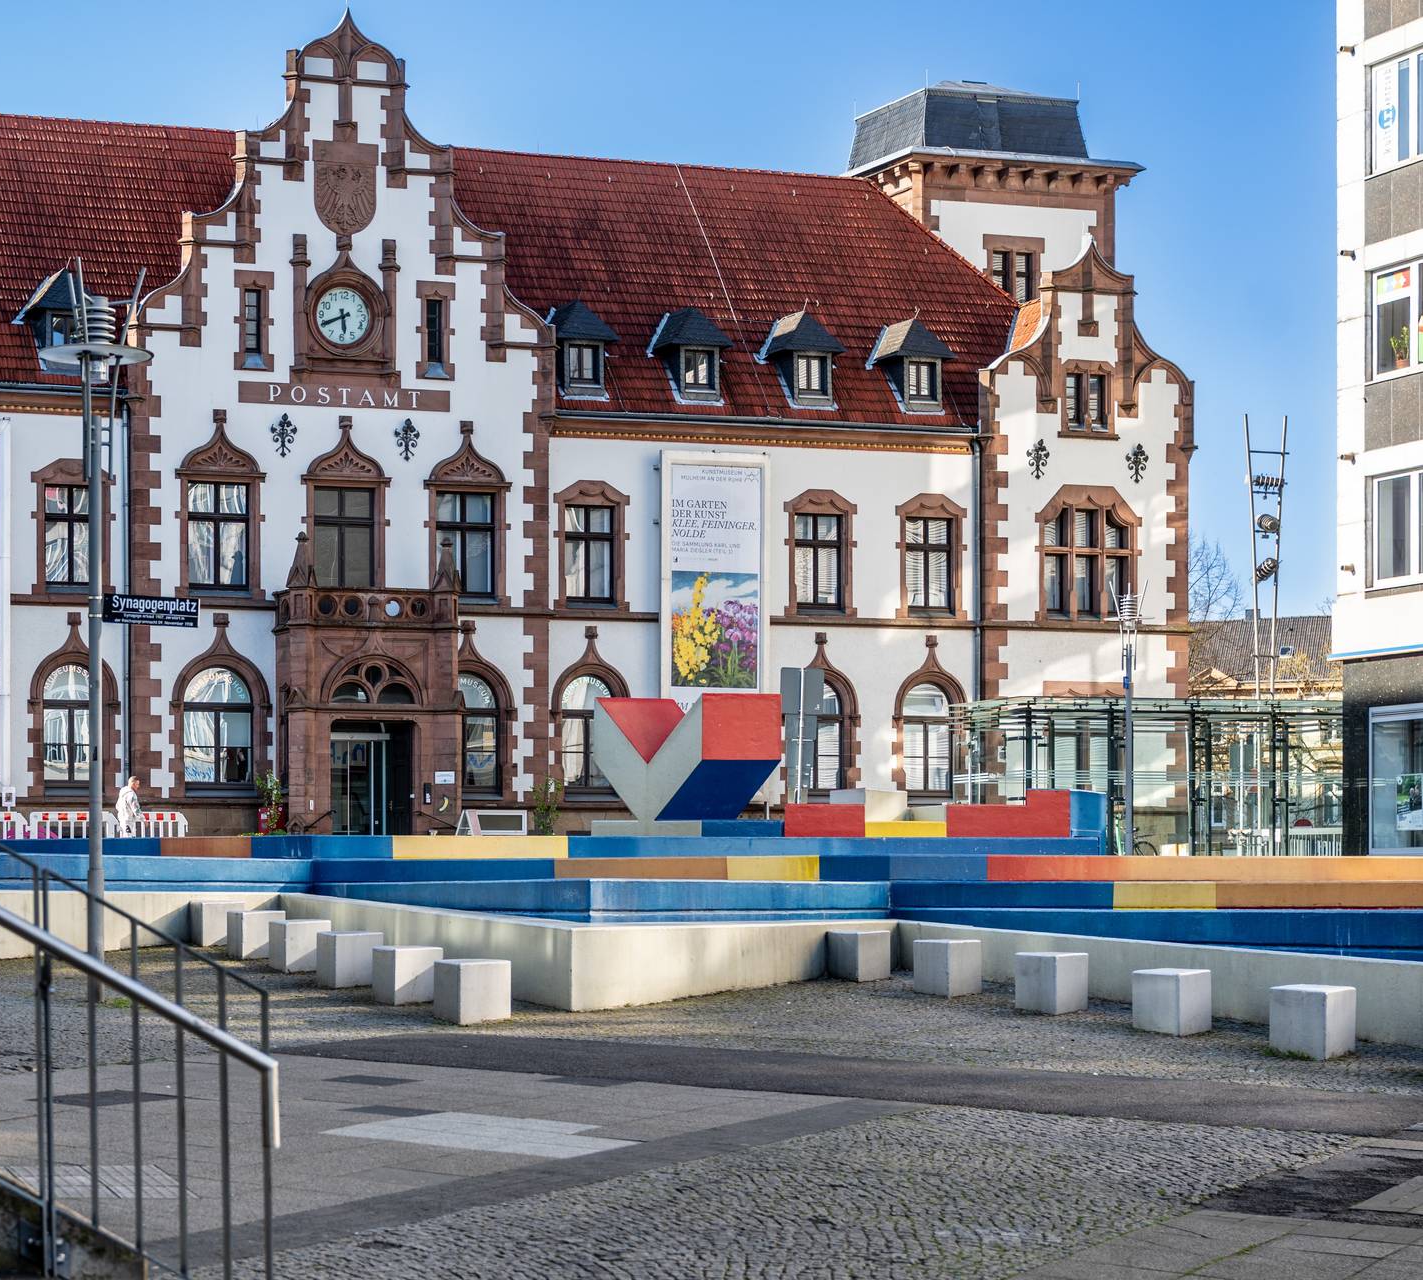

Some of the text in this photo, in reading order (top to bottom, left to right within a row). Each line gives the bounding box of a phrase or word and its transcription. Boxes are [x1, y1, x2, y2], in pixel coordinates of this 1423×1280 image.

[328, 293, 337, 302] 11
[338, 291, 349, 300] 12
[351, 294, 356, 303] 1
[320, 301, 331, 310] 10
[357, 304, 363, 313] 2
[318, 310, 325, 319] 9
[360, 314, 367, 322] 3
[328, 329, 335, 338] 7
[338, 333, 345, 342] 6
[349, 331, 356, 340] 5
[268, 384, 421, 409] POSTAMT
[672, 498, 728, 510] IM GARTEN
[672, 509, 727, 519] DER KUNST
[671, 519, 757, 531] KLEE, FEININGER,
[671, 529, 707, 539] NOLDE
[112, 595, 197, 614] Synagogenplatz
[459, 677, 491, 705] MUSEUM
[561, 676, 611, 704] KUNSTMUSEU
